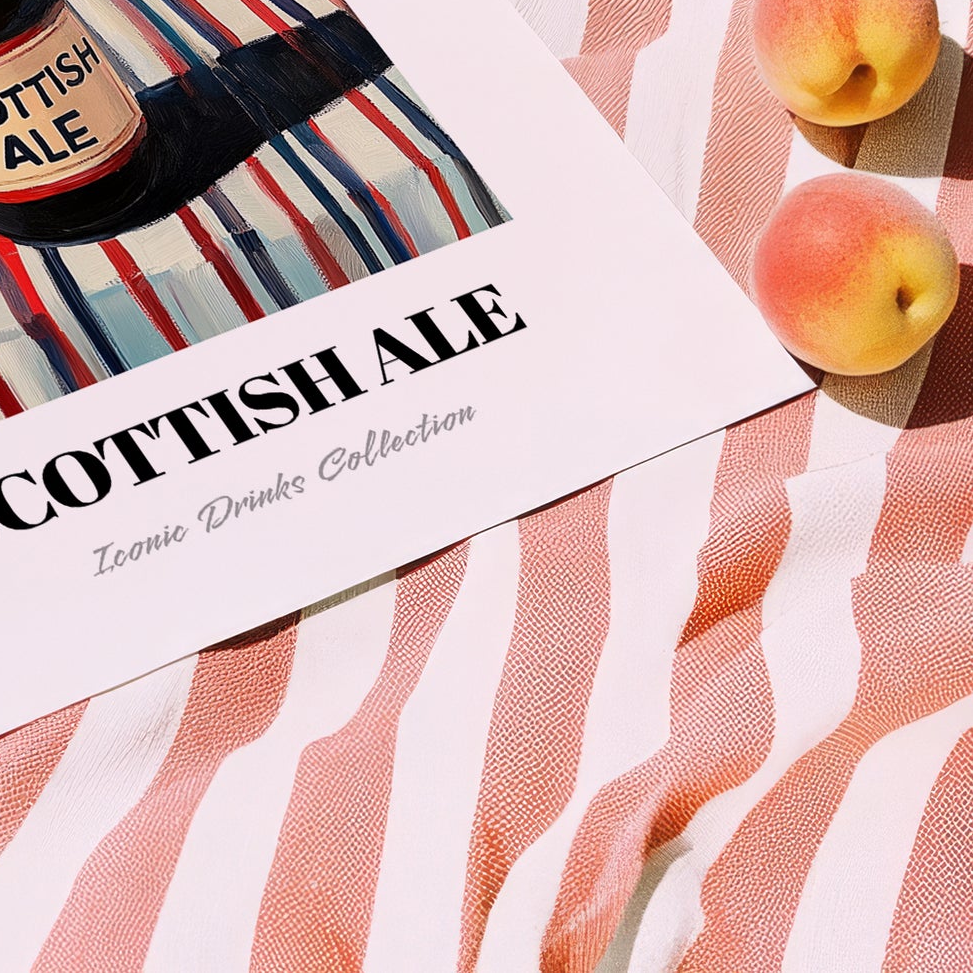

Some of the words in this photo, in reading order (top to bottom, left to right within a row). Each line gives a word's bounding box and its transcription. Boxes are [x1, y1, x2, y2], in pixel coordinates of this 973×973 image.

[3, 109, 99, 170] ALE
[371, 283, 529, 387] ALE
[92, 525, 189, 578] Iconic
[197, 472, 307, 533] Drinks
[318, 405, 477, 482] Collection
